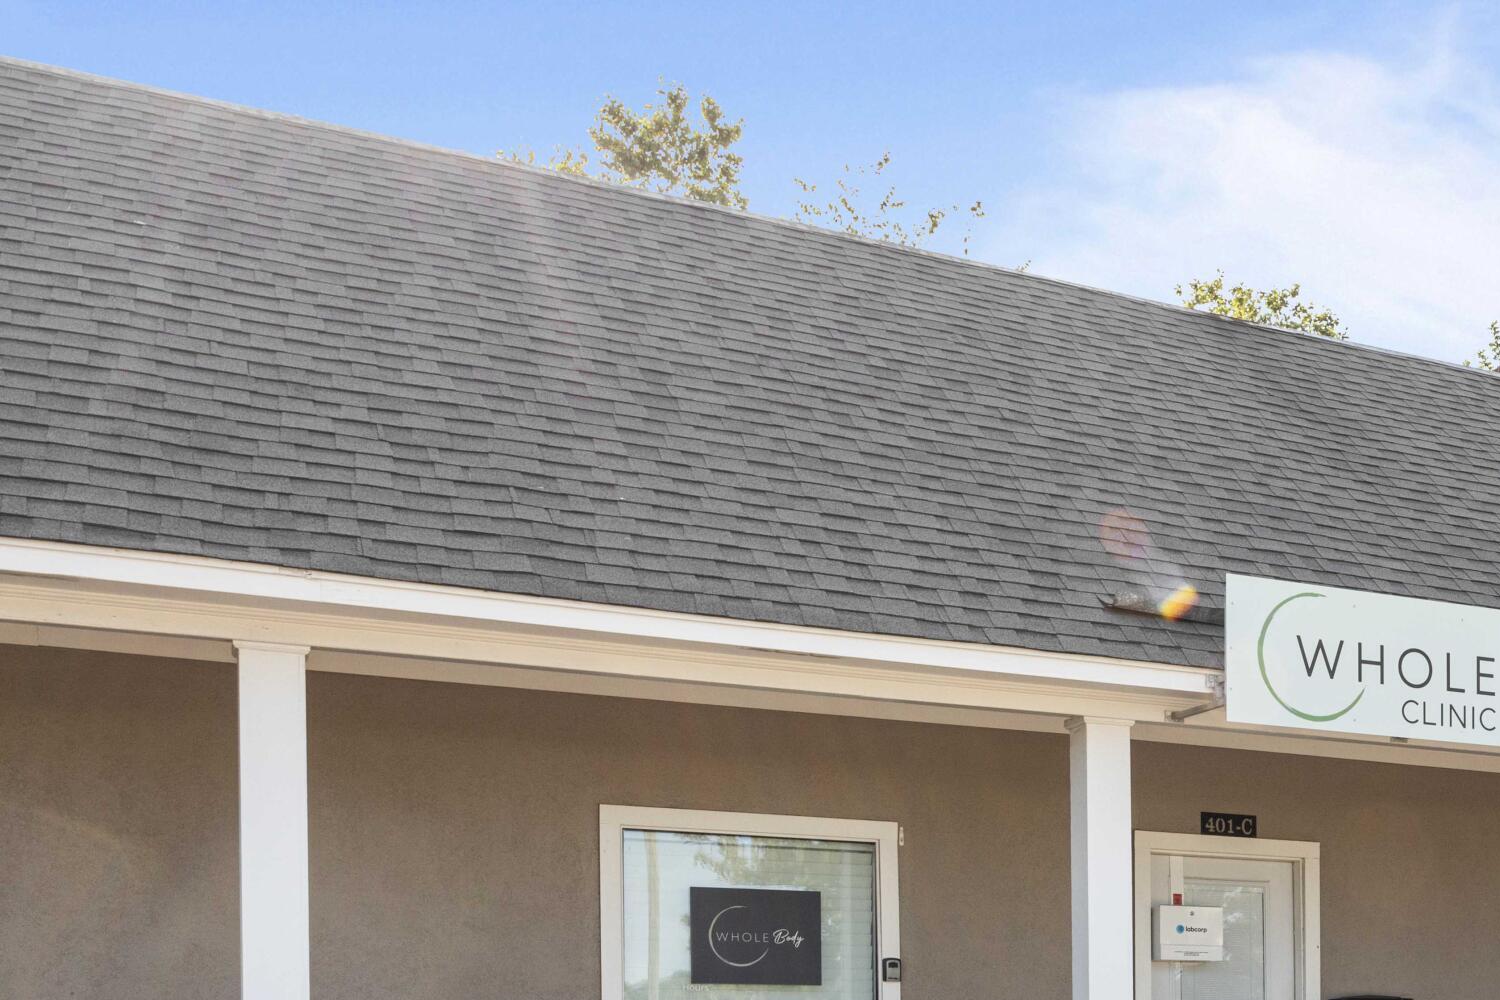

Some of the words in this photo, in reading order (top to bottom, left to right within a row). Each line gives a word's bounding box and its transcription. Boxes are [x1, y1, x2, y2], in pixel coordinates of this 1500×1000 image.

[1296, 634, 1496, 697] WHOLE
[1401, 699, 1496, 732] CLINIC
[1205, 816, 1253, 835] 401-C
[716, 931, 769, 943] WHOLE
[772, 928, 805, 949] Body
[1185, 925, 1208, 934] labcorp
